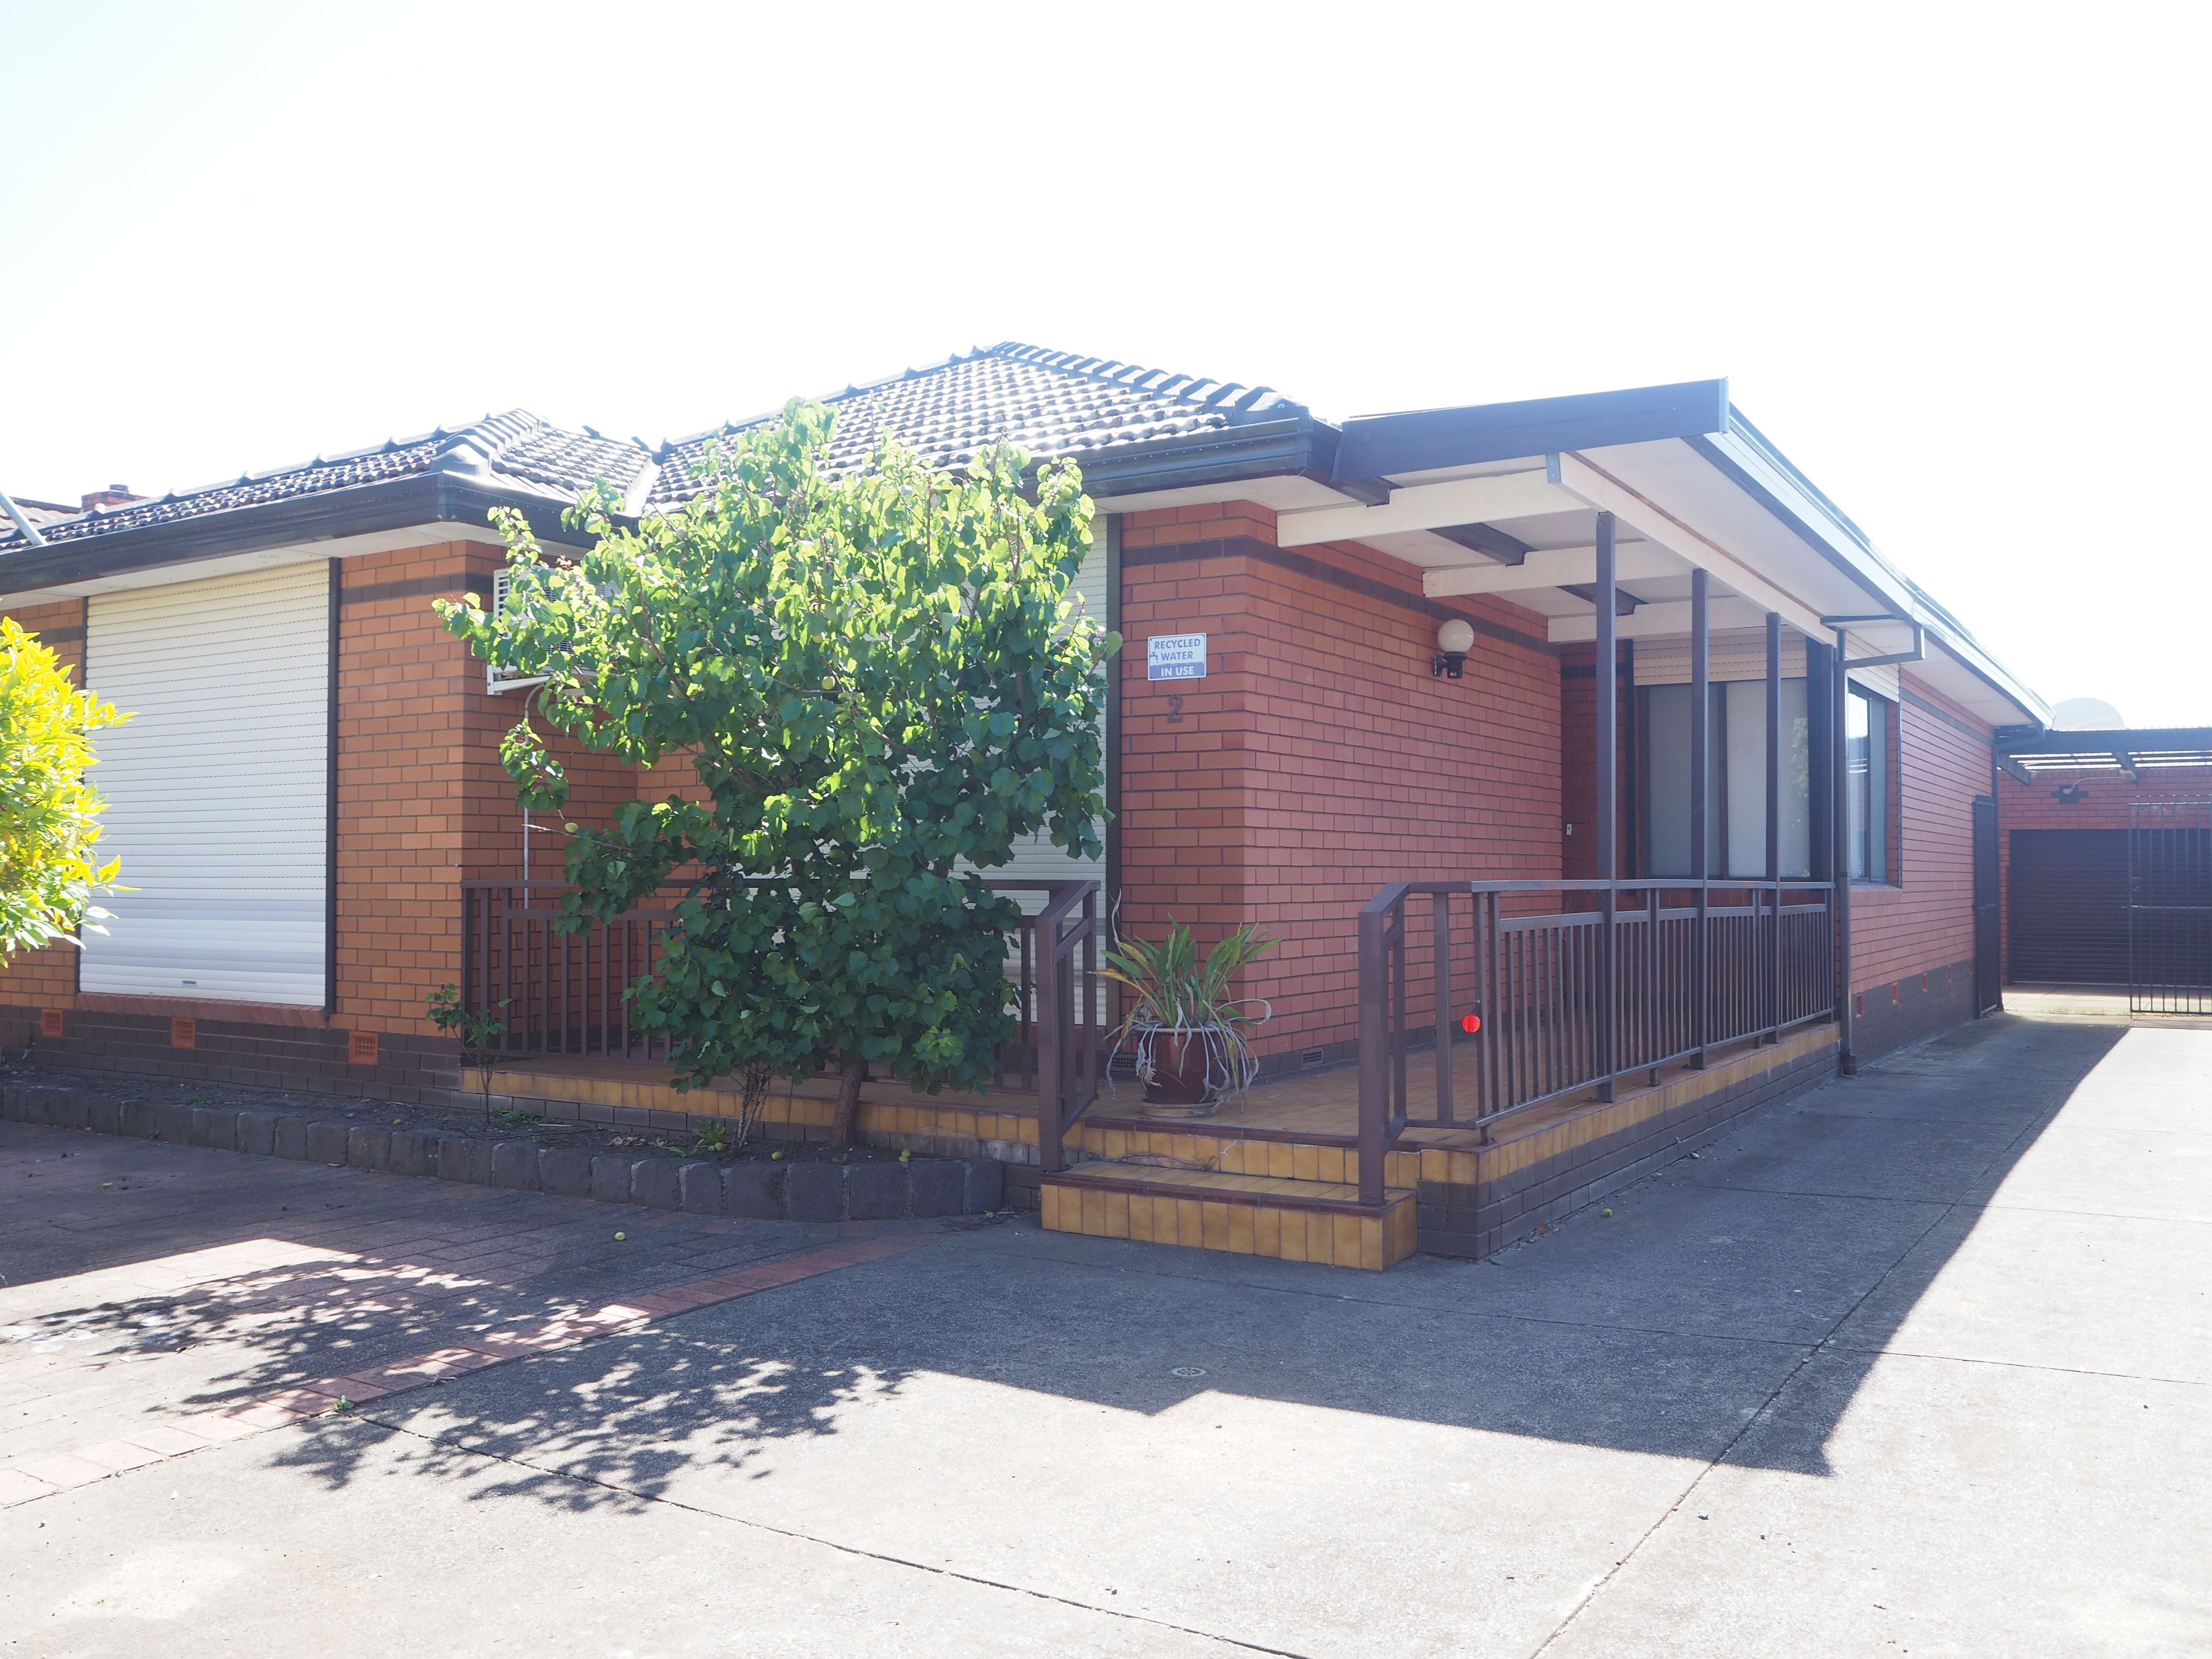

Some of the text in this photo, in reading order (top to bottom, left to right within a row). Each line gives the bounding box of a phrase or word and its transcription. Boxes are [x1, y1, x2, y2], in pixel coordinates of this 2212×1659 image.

[1154, 639, 1200, 649] RECYCLED
[1161, 651, 1193, 661] WATER
[1161, 666, 1194, 676] IN USE
[1167, 694, 1183, 723] 2
